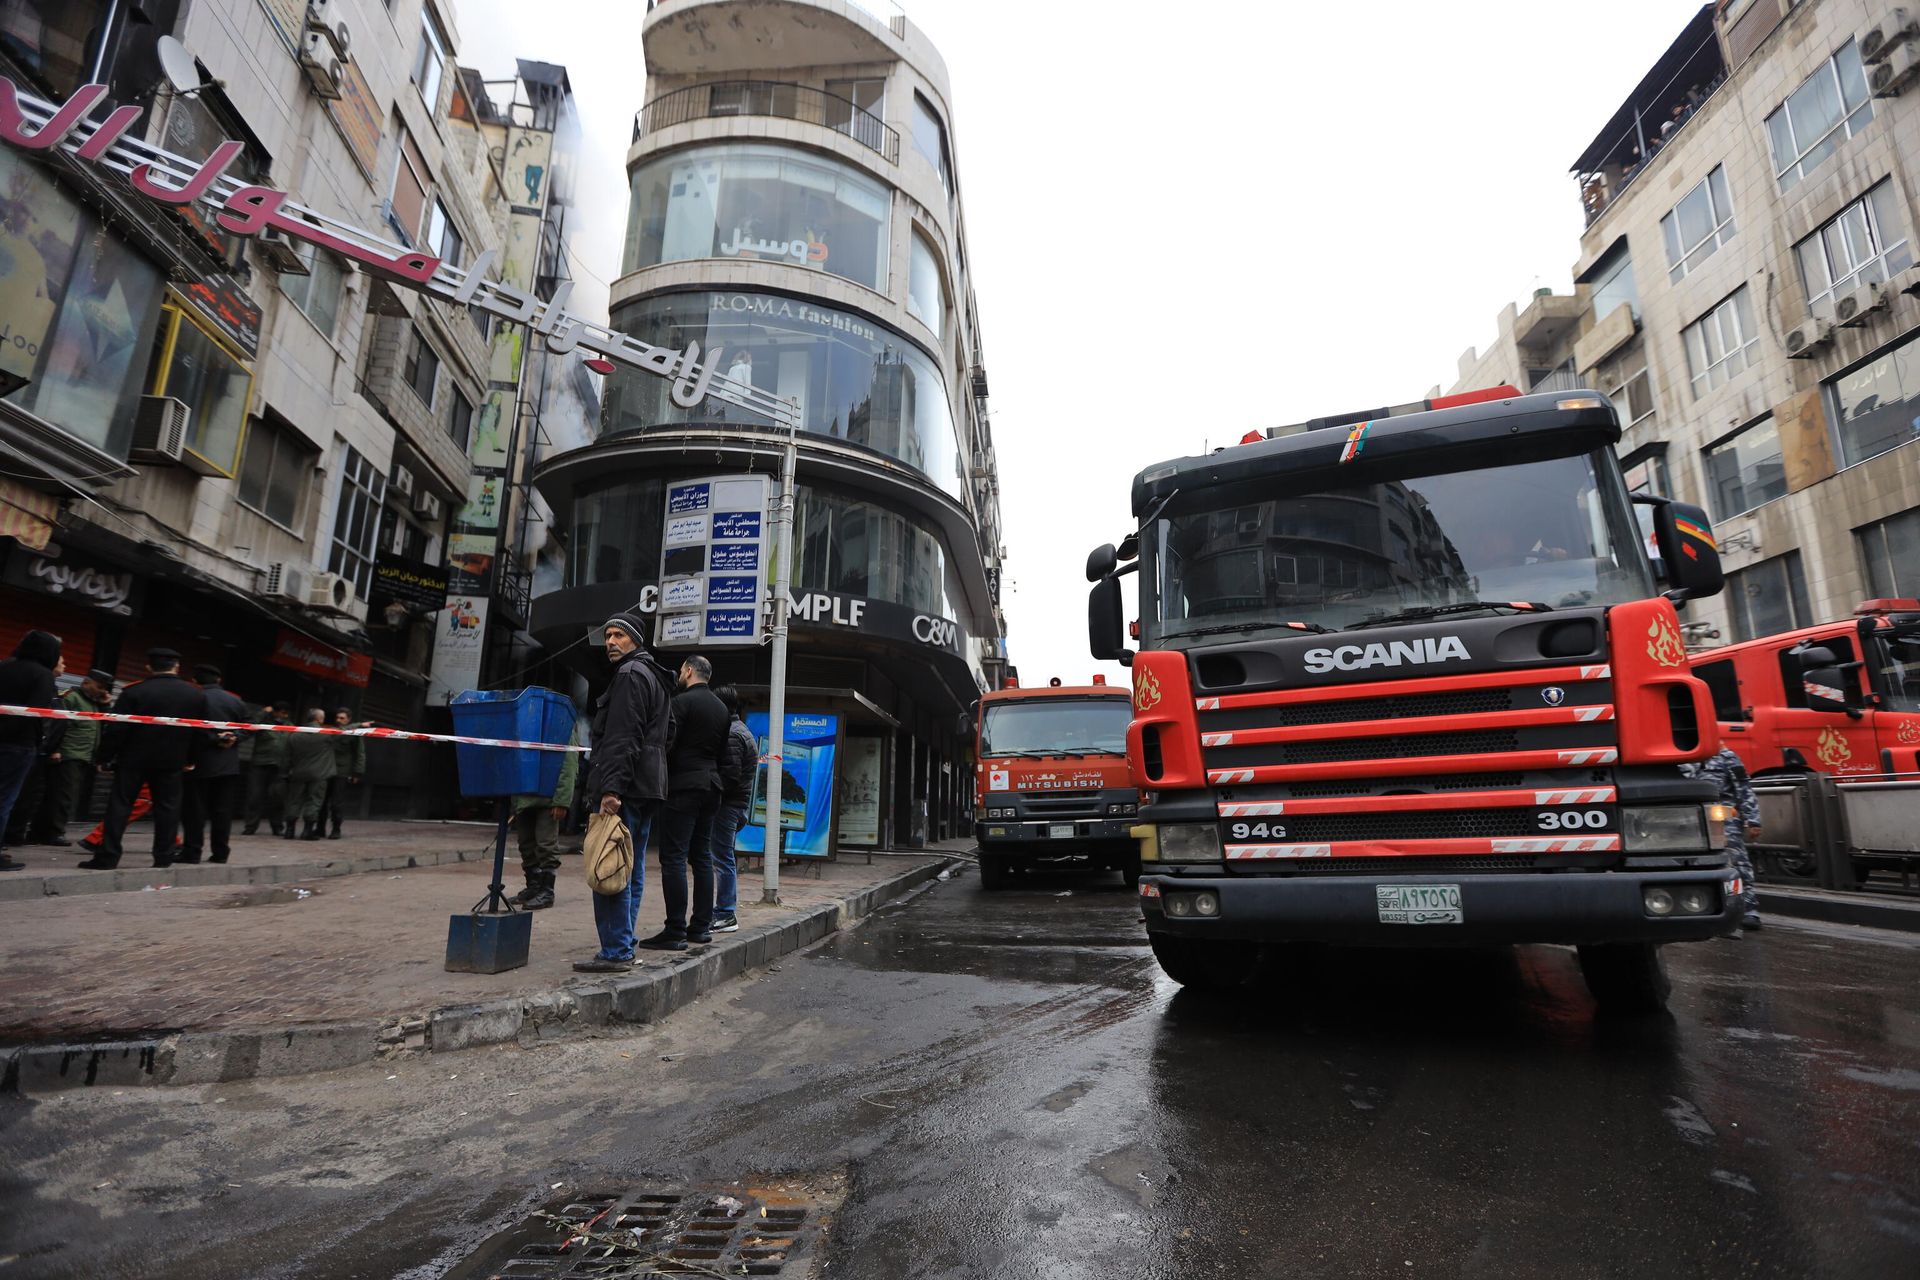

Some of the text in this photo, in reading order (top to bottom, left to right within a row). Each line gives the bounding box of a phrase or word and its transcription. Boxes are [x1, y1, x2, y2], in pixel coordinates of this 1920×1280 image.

[713, 295, 875, 341] ROMA fashion
[723, 528, 750, 538] جراحة عامة
[912, 613, 960, 651] C&M
[1303, 635, 1472, 674] SCANIA
[791, 716, 827, 728] المستقبل
[1017, 779, 1105, 790] MITSUBISHI
[1537, 810, 1608, 830] 300
[1232, 822, 1287, 840] 94G
[1379, 900, 1400, 909] SYR
[1402, 888, 1459, 908] ٨٩٣٥٢٥
[1414, 912, 1456, 922] دمشق
